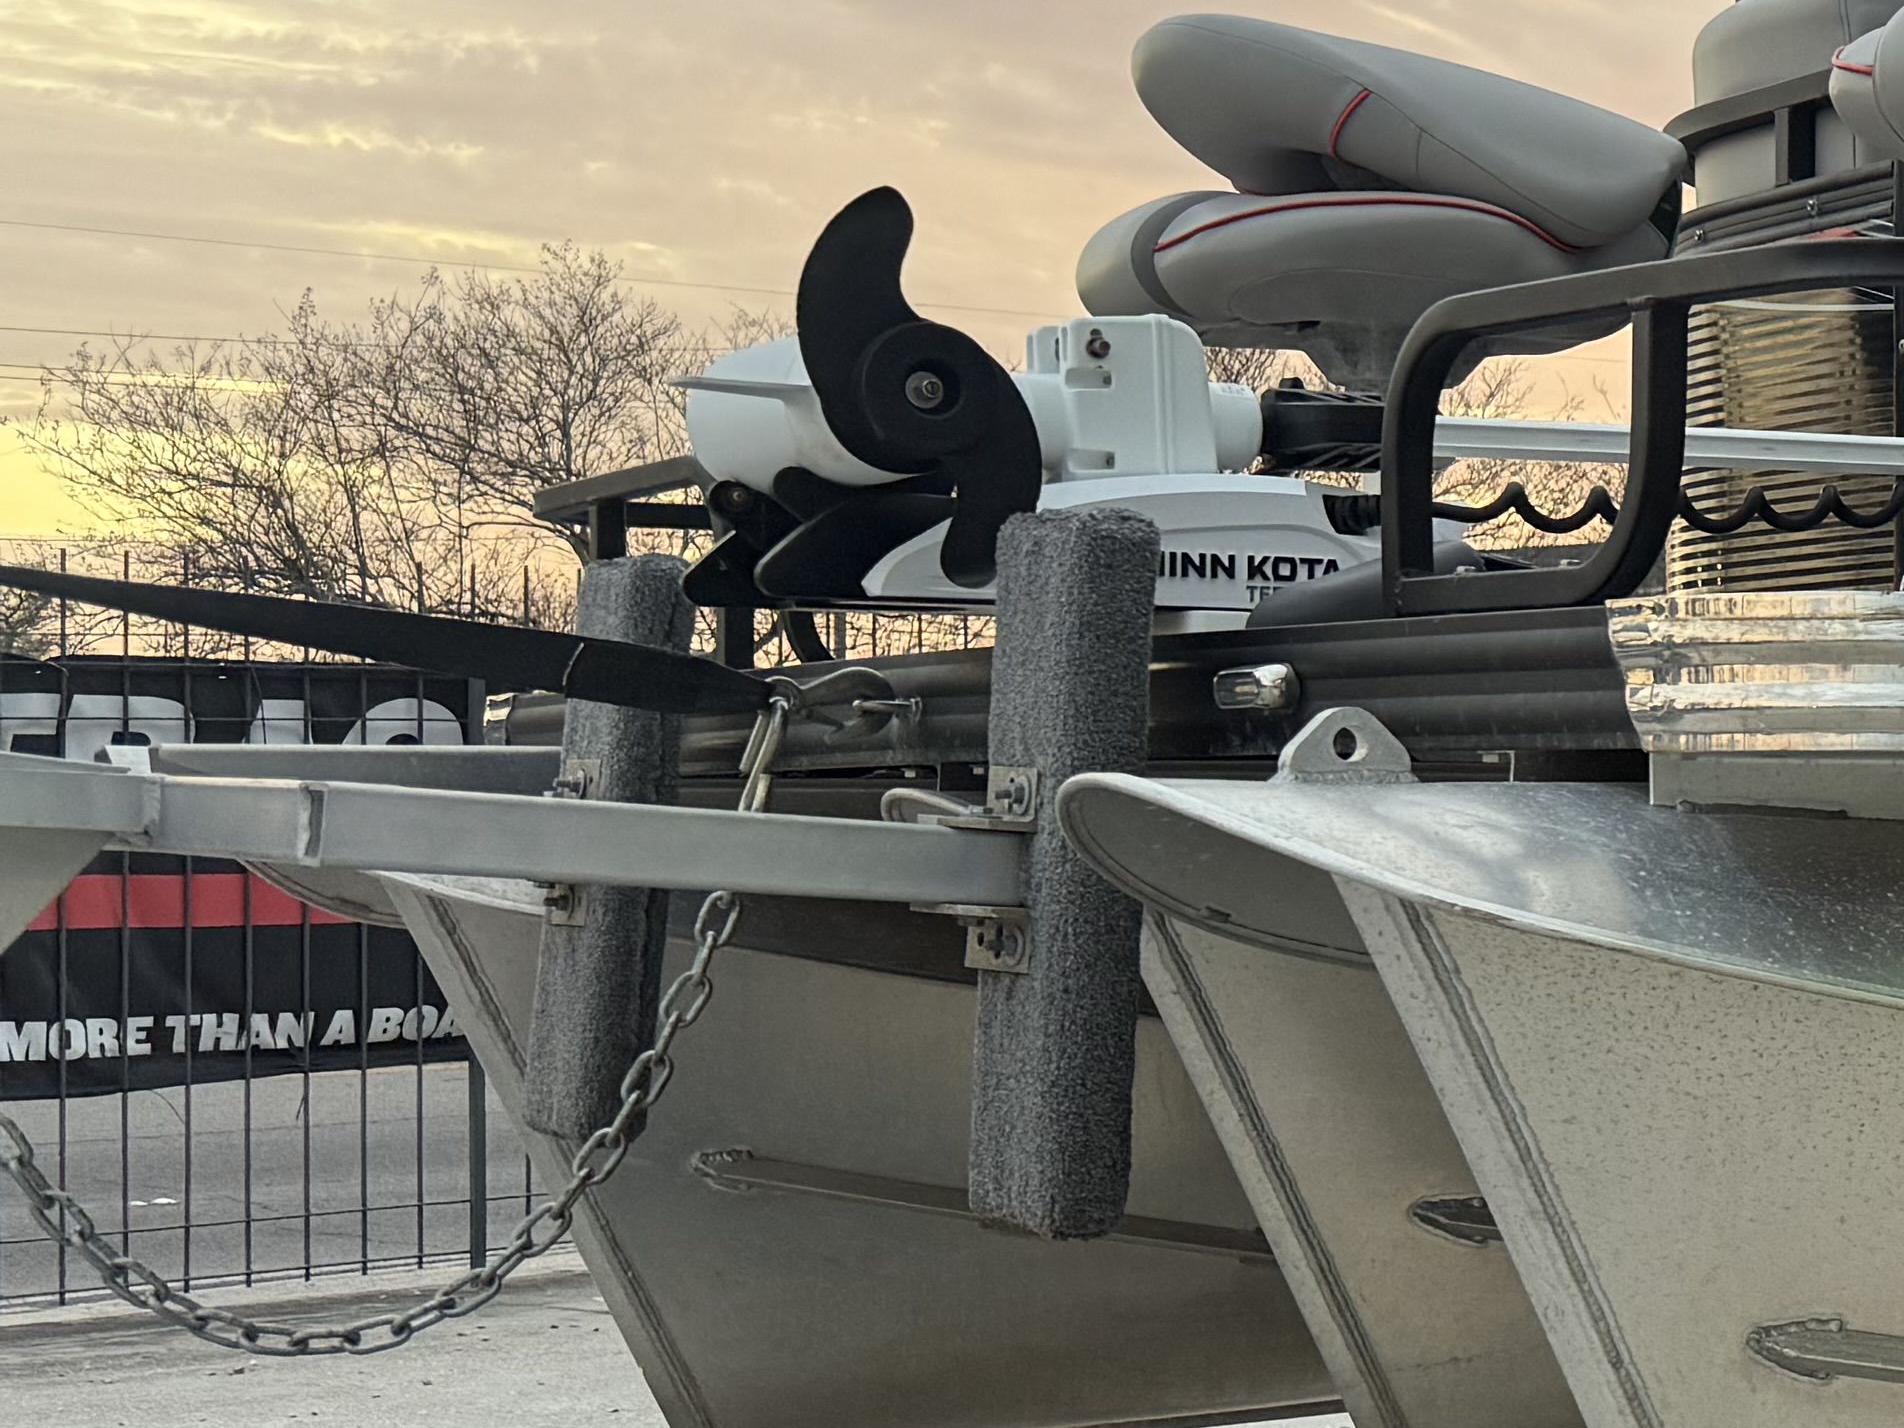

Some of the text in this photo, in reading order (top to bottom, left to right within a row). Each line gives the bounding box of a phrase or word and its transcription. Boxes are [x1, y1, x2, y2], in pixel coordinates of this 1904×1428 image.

[0, 1016, 154, 1061] MORE
[165, 1012, 316, 1053] THAN
[320, 1009, 356, 1046] A
